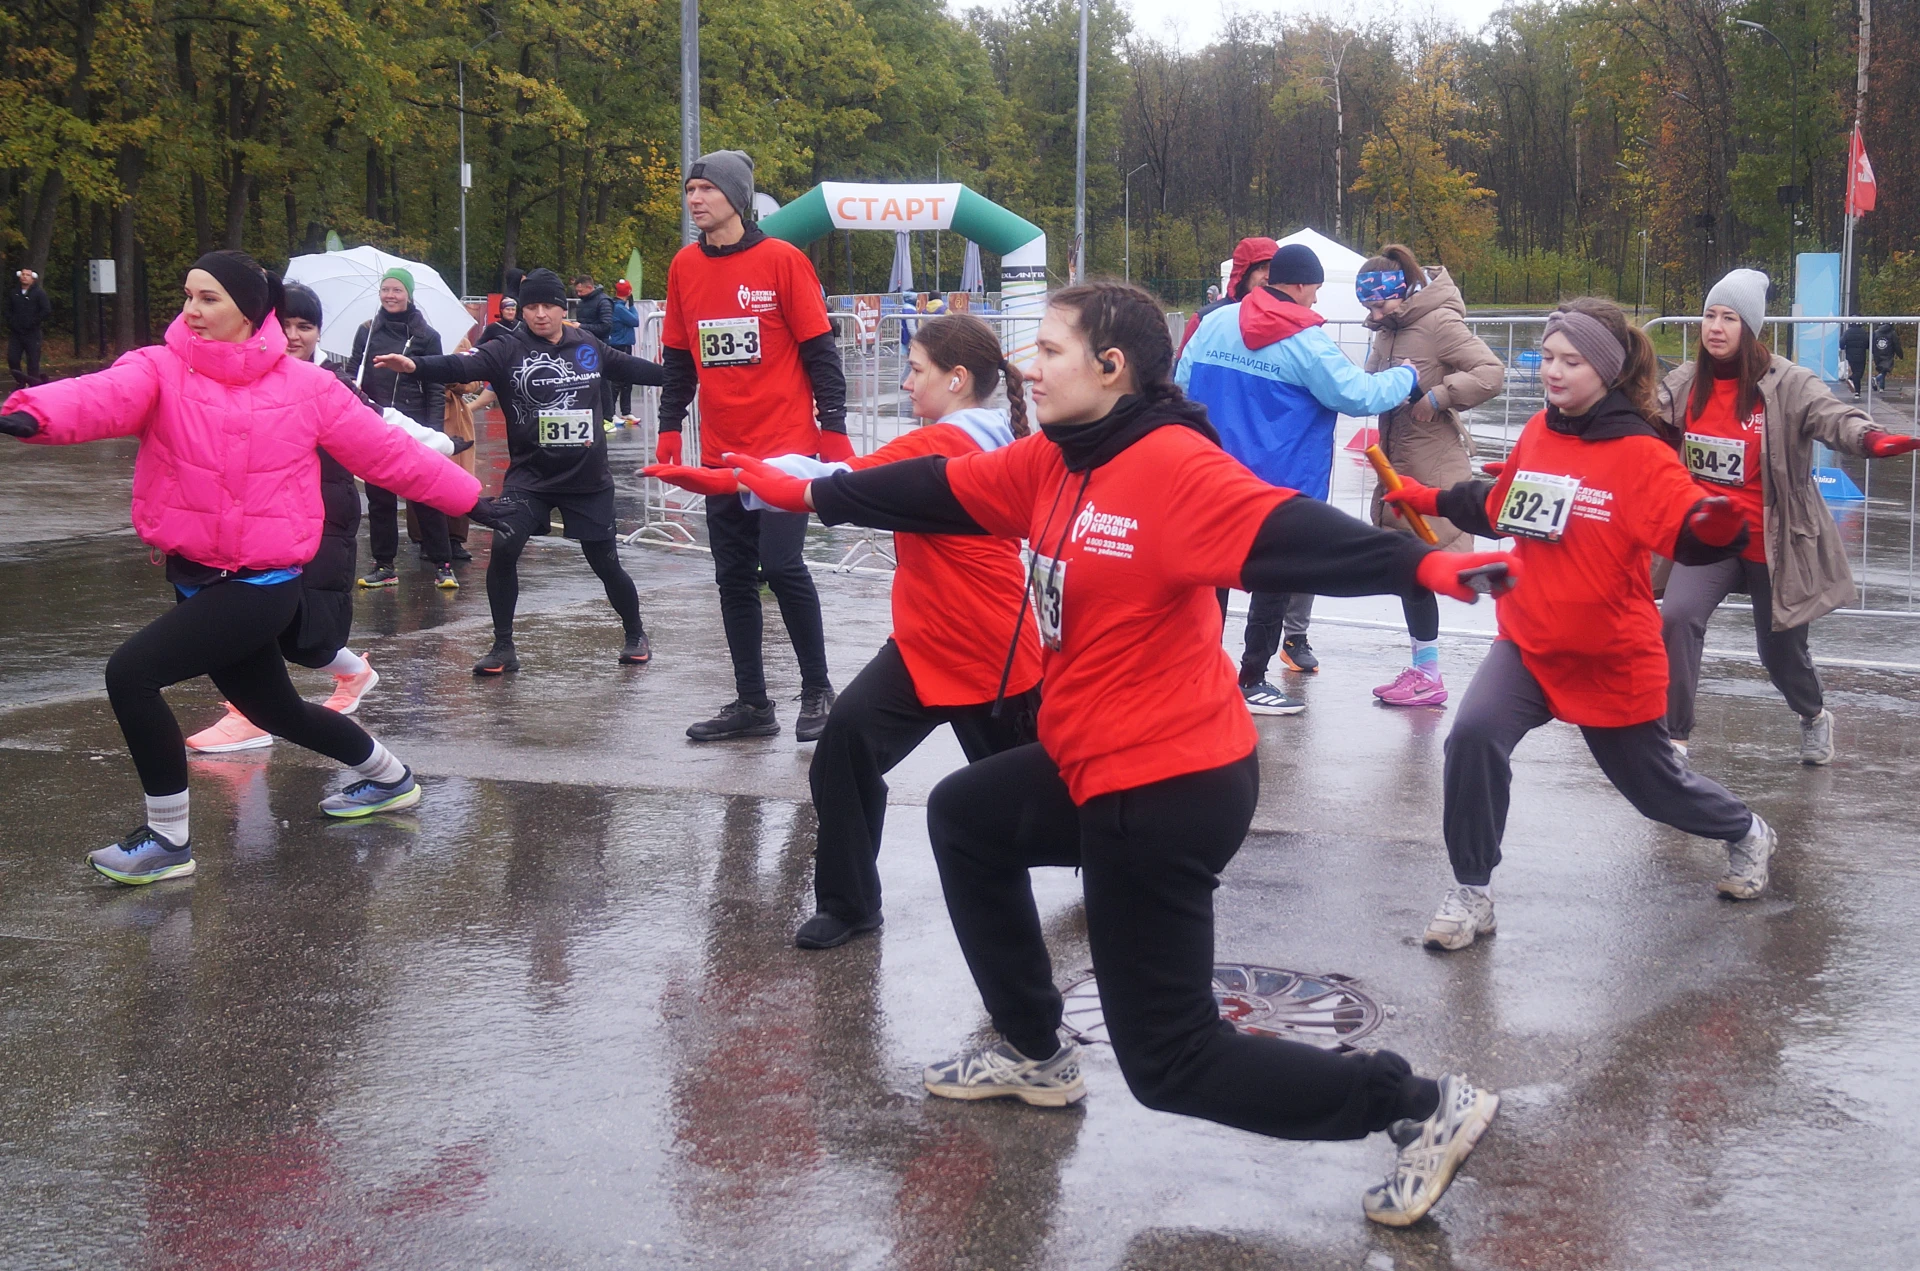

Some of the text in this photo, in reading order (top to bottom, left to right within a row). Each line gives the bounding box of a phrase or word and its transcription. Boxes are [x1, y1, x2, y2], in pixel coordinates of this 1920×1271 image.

[837, 197, 945, 221] СТАРТ
[706, 331, 759, 356] 33-3
[1206, 350, 1281, 375] #АРЕНАИДЕЙ
[546, 421, 590, 440] 31-2
[1692, 448, 1741, 476] 34-2
[1574, 495, 1605, 506] КРОВИ
[1576, 486, 1613, 501] СЛУЖБА
[1508, 490, 1566, 527] 32-1
[1089, 522, 1127, 538] КРОВИ
[1093, 512, 1138, 530] СЛУЖБА
